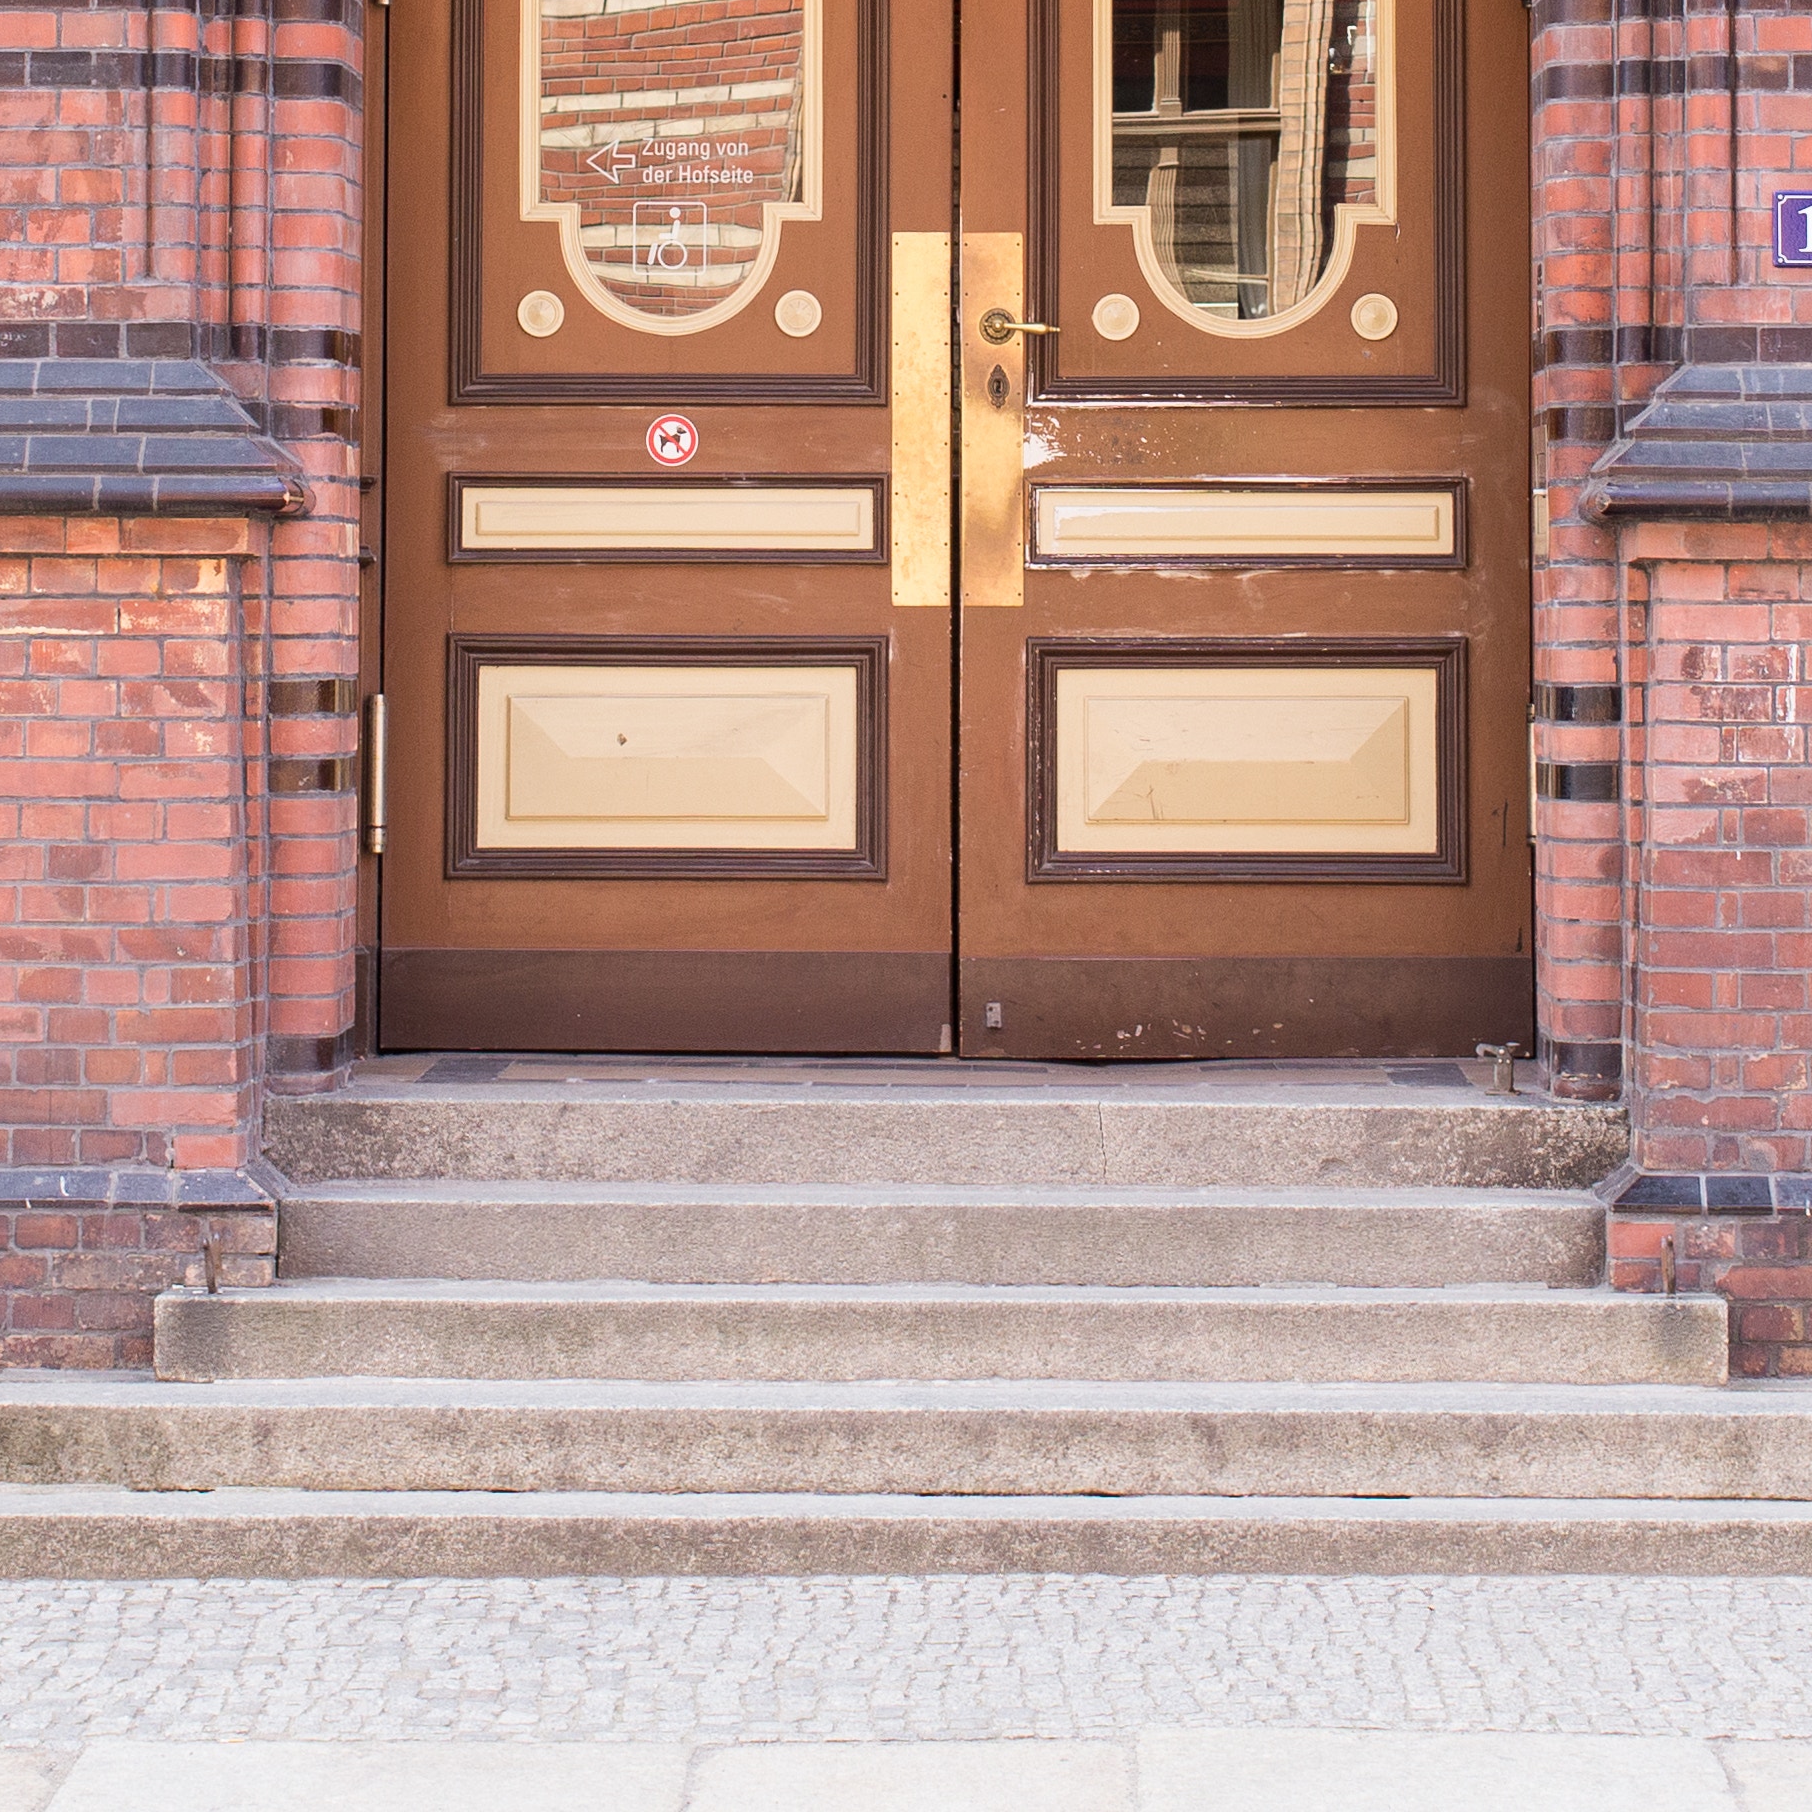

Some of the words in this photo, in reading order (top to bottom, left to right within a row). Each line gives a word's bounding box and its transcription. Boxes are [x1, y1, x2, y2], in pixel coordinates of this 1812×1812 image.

[642, 138, 711, 161] Zugang
[716, 142, 749, 156] von
[642, 166, 674, 184] der
[678, 165, 754, 184] Hofseite
